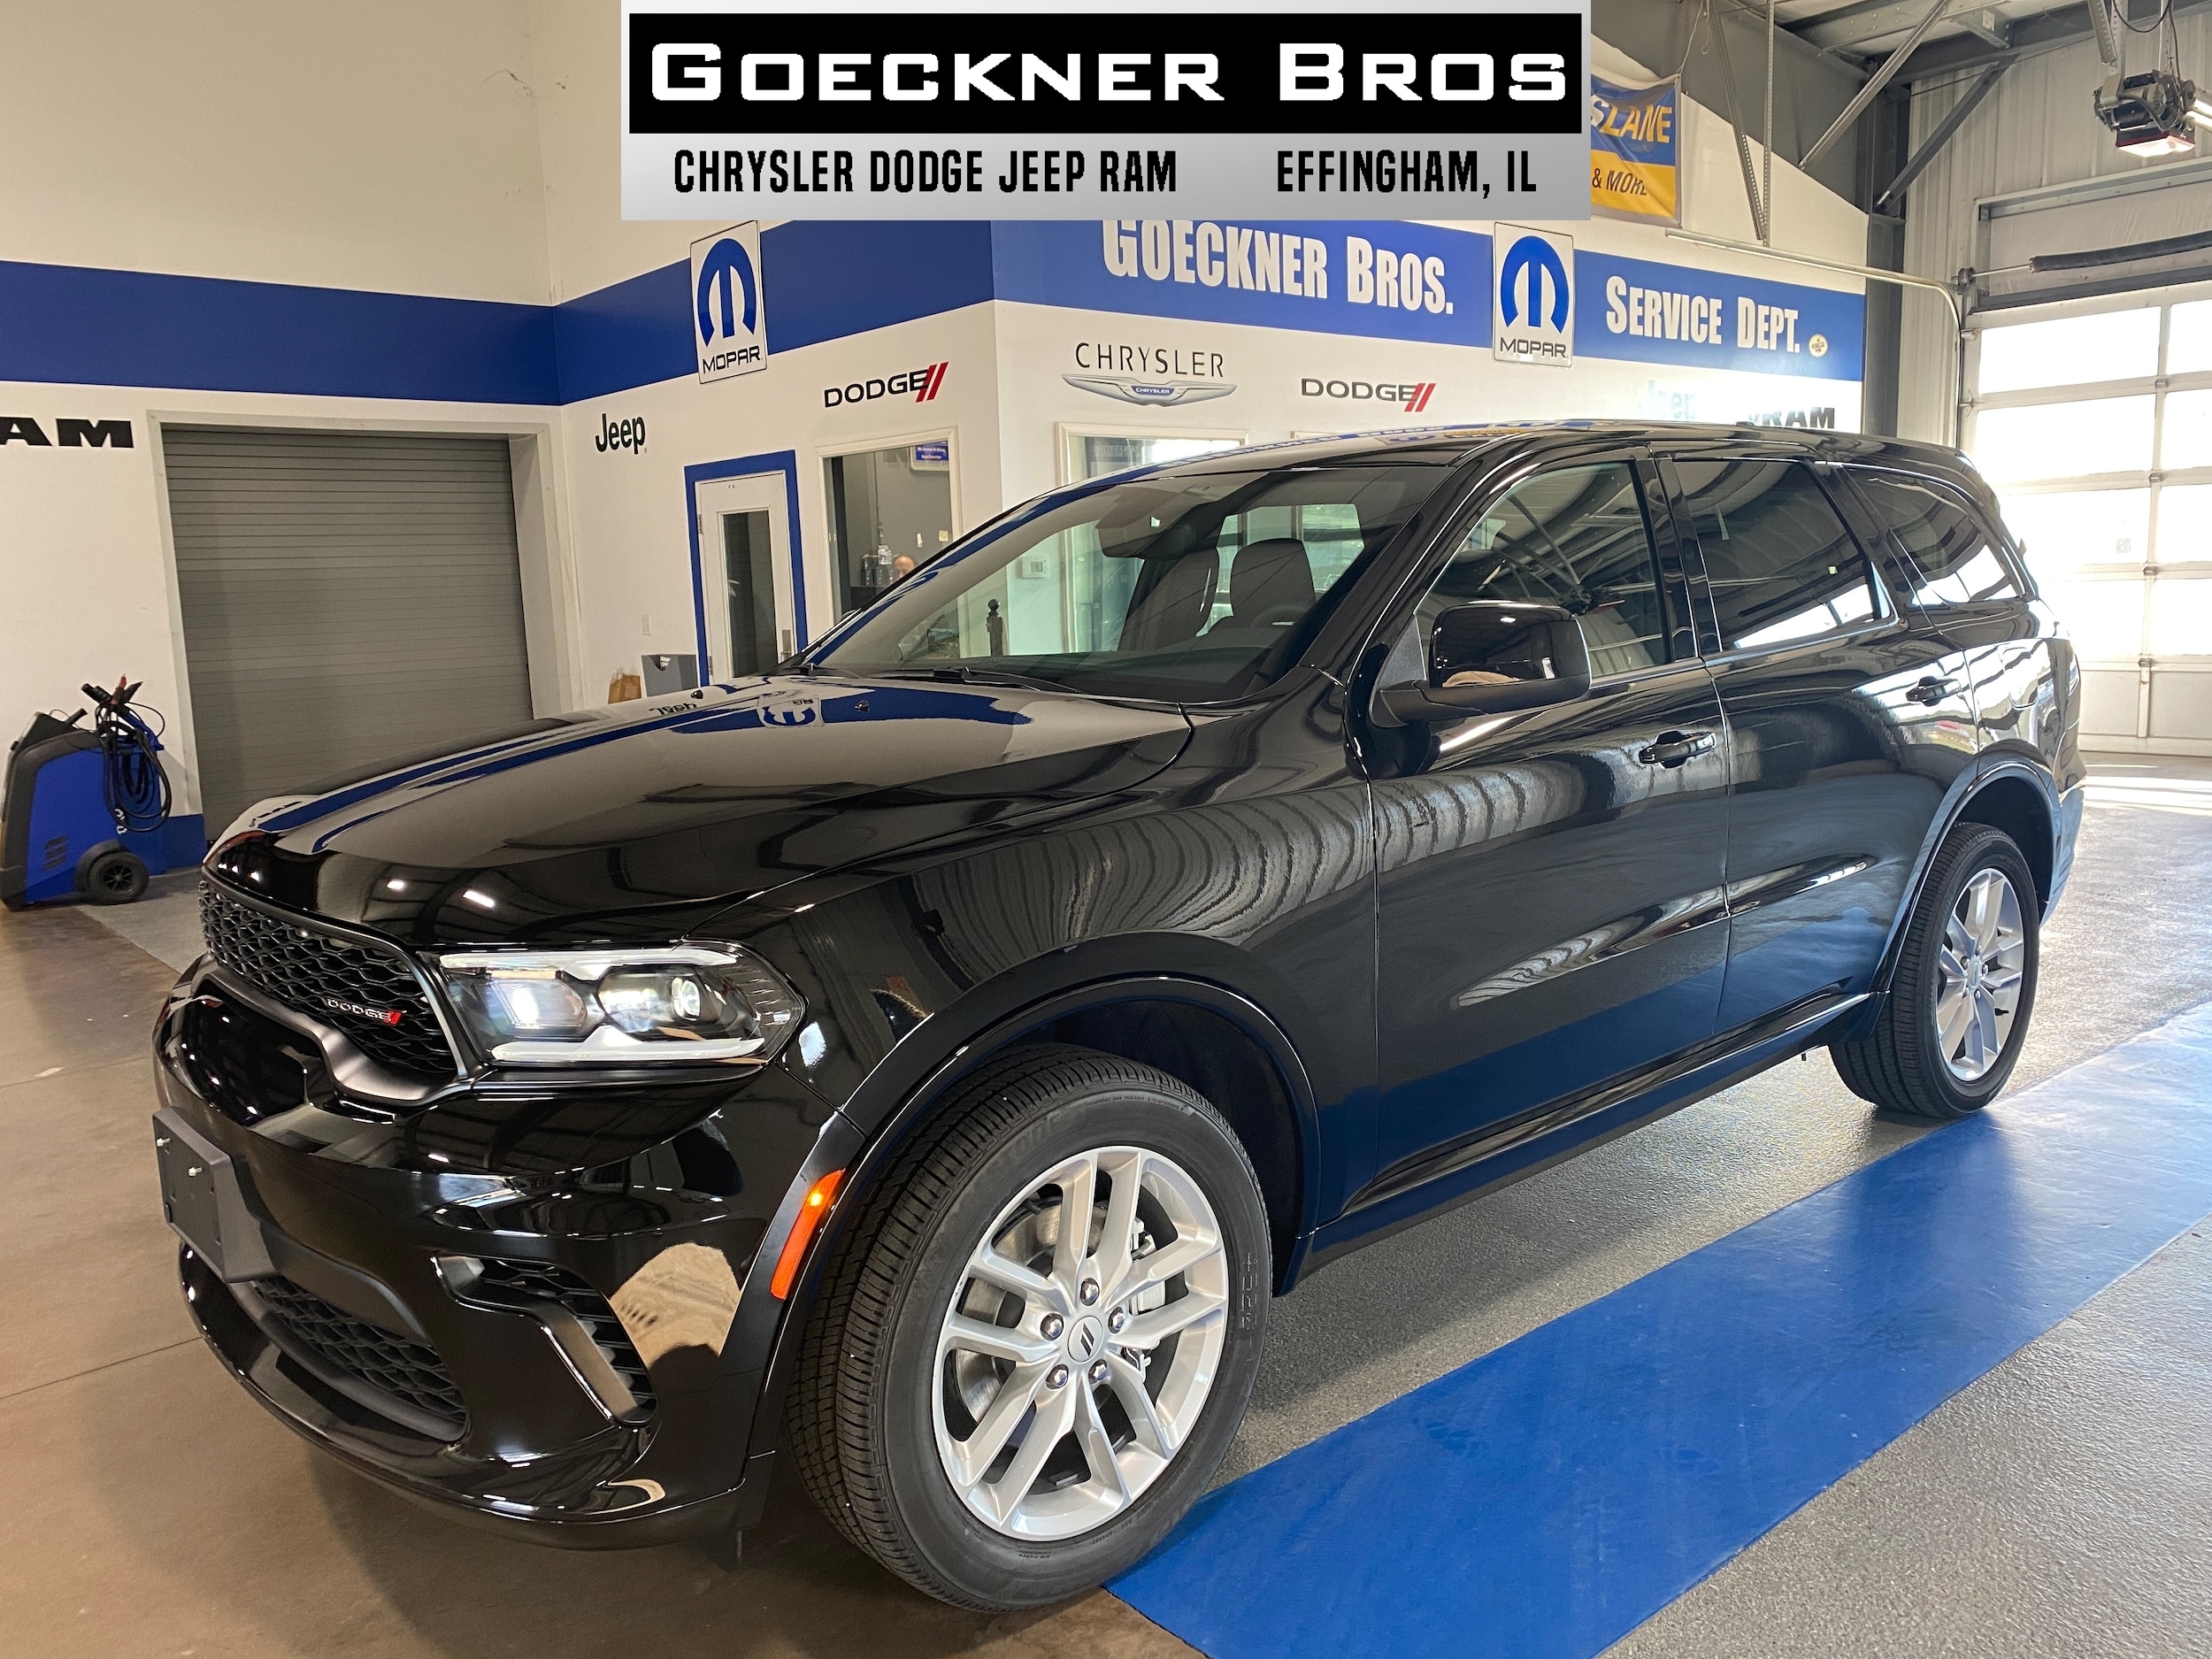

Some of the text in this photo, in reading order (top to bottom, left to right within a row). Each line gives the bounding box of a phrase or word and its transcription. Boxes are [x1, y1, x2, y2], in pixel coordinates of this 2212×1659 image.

[1592, 168, 1601, 189] &
[1102, 220, 1454, 315] GOECKNER BROS.
[1606, 275, 1801, 353] SERVICE DEPT.
[703, 345, 761, 374] MOPAR
[1075, 342, 1224, 378] CHRYSLER
[1500, 337, 1567, 358] MOPAR
[824, 369, 929, 408] DODGE
[1302, 378, 1417, 402] DODGE
[1762, 407, 1835, 428] RAM
[595, 413, 645, 455] Jeep
[327, 998, 391, 1021] DODGE
